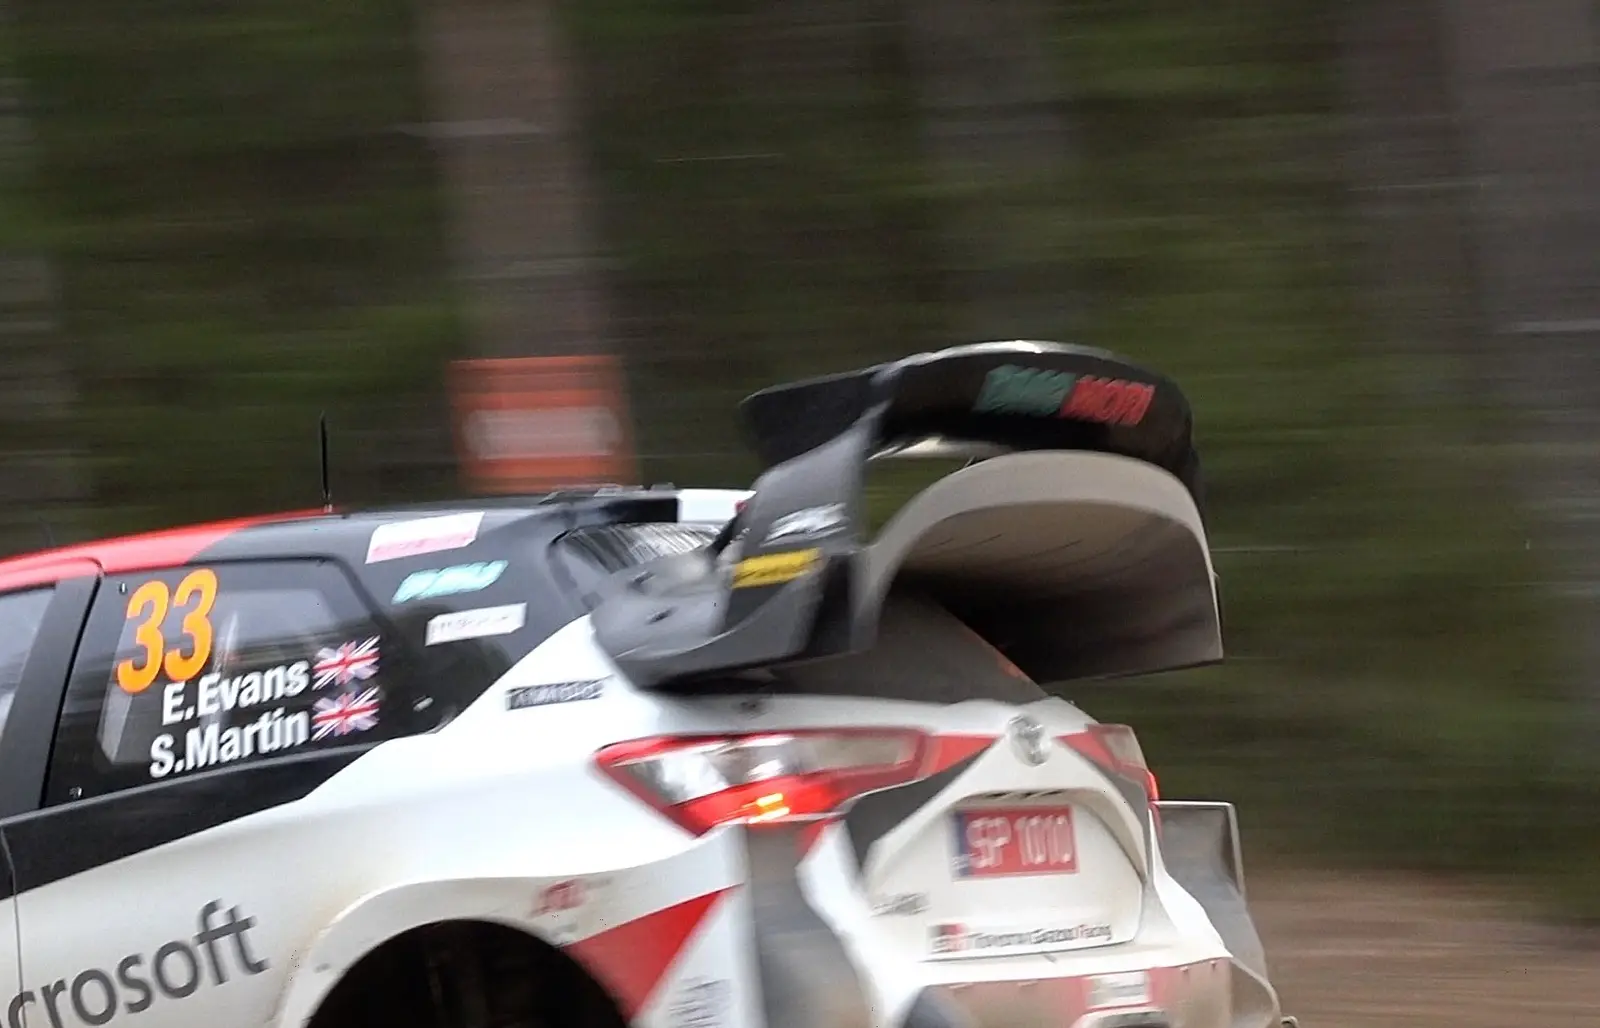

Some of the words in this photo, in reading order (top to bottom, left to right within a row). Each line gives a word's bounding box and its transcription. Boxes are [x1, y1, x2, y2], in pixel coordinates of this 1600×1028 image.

[117, 568, 217, 693] 33
[162, 660, 309, 726] E.Evans
[150, 707, 310, 778] S.Martin
